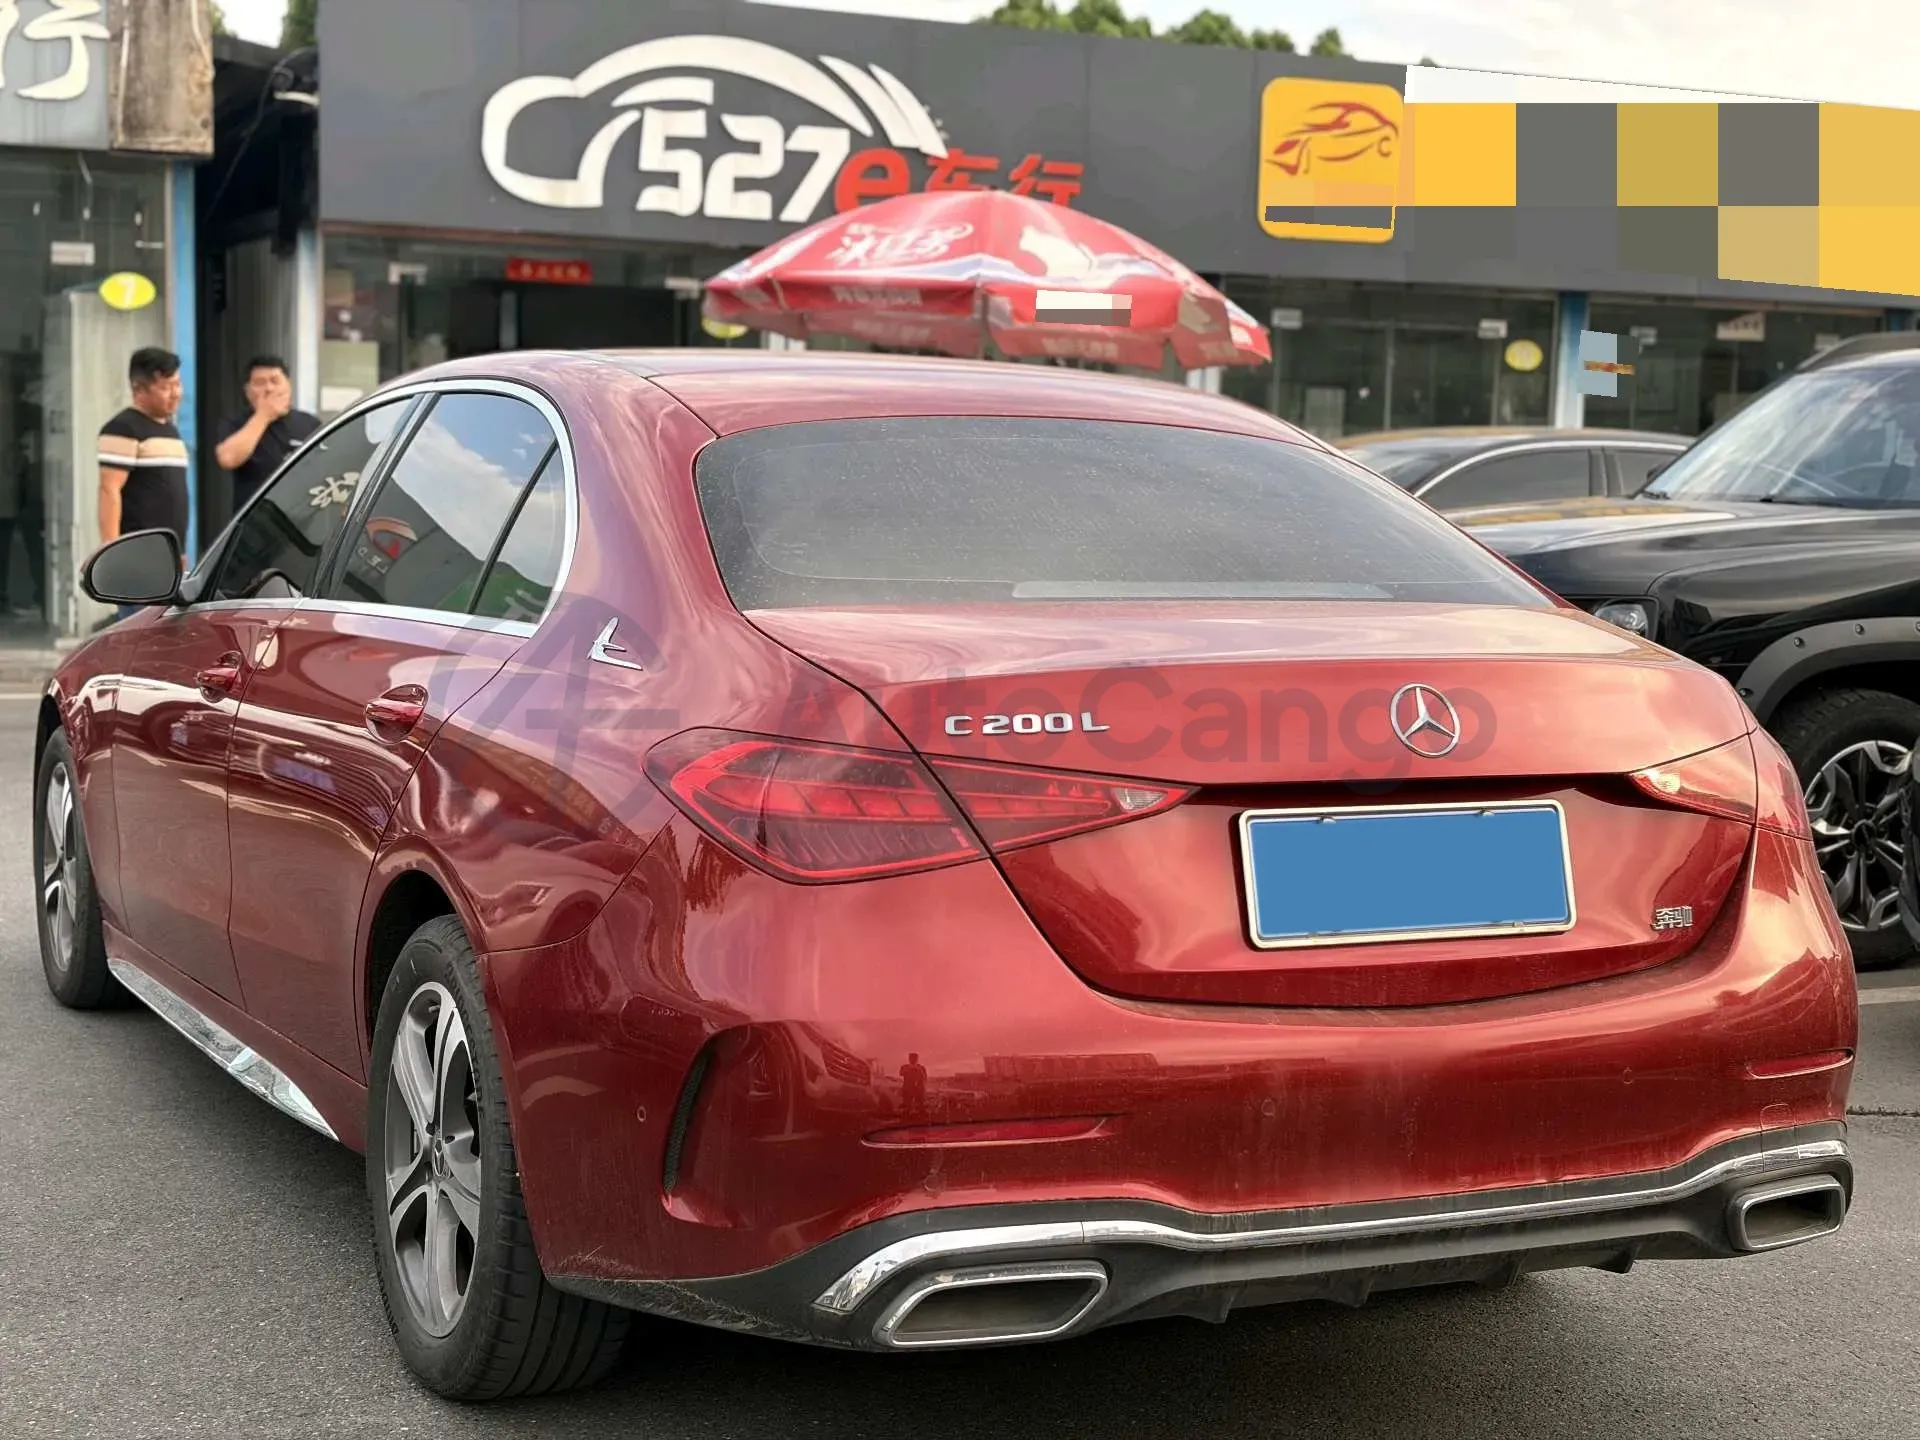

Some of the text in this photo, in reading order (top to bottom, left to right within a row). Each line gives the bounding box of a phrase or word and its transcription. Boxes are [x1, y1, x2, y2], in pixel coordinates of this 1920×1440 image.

[945, 711, 1111, 735] C 200 L
[1652, 905, 1694, 929] 奔驰
